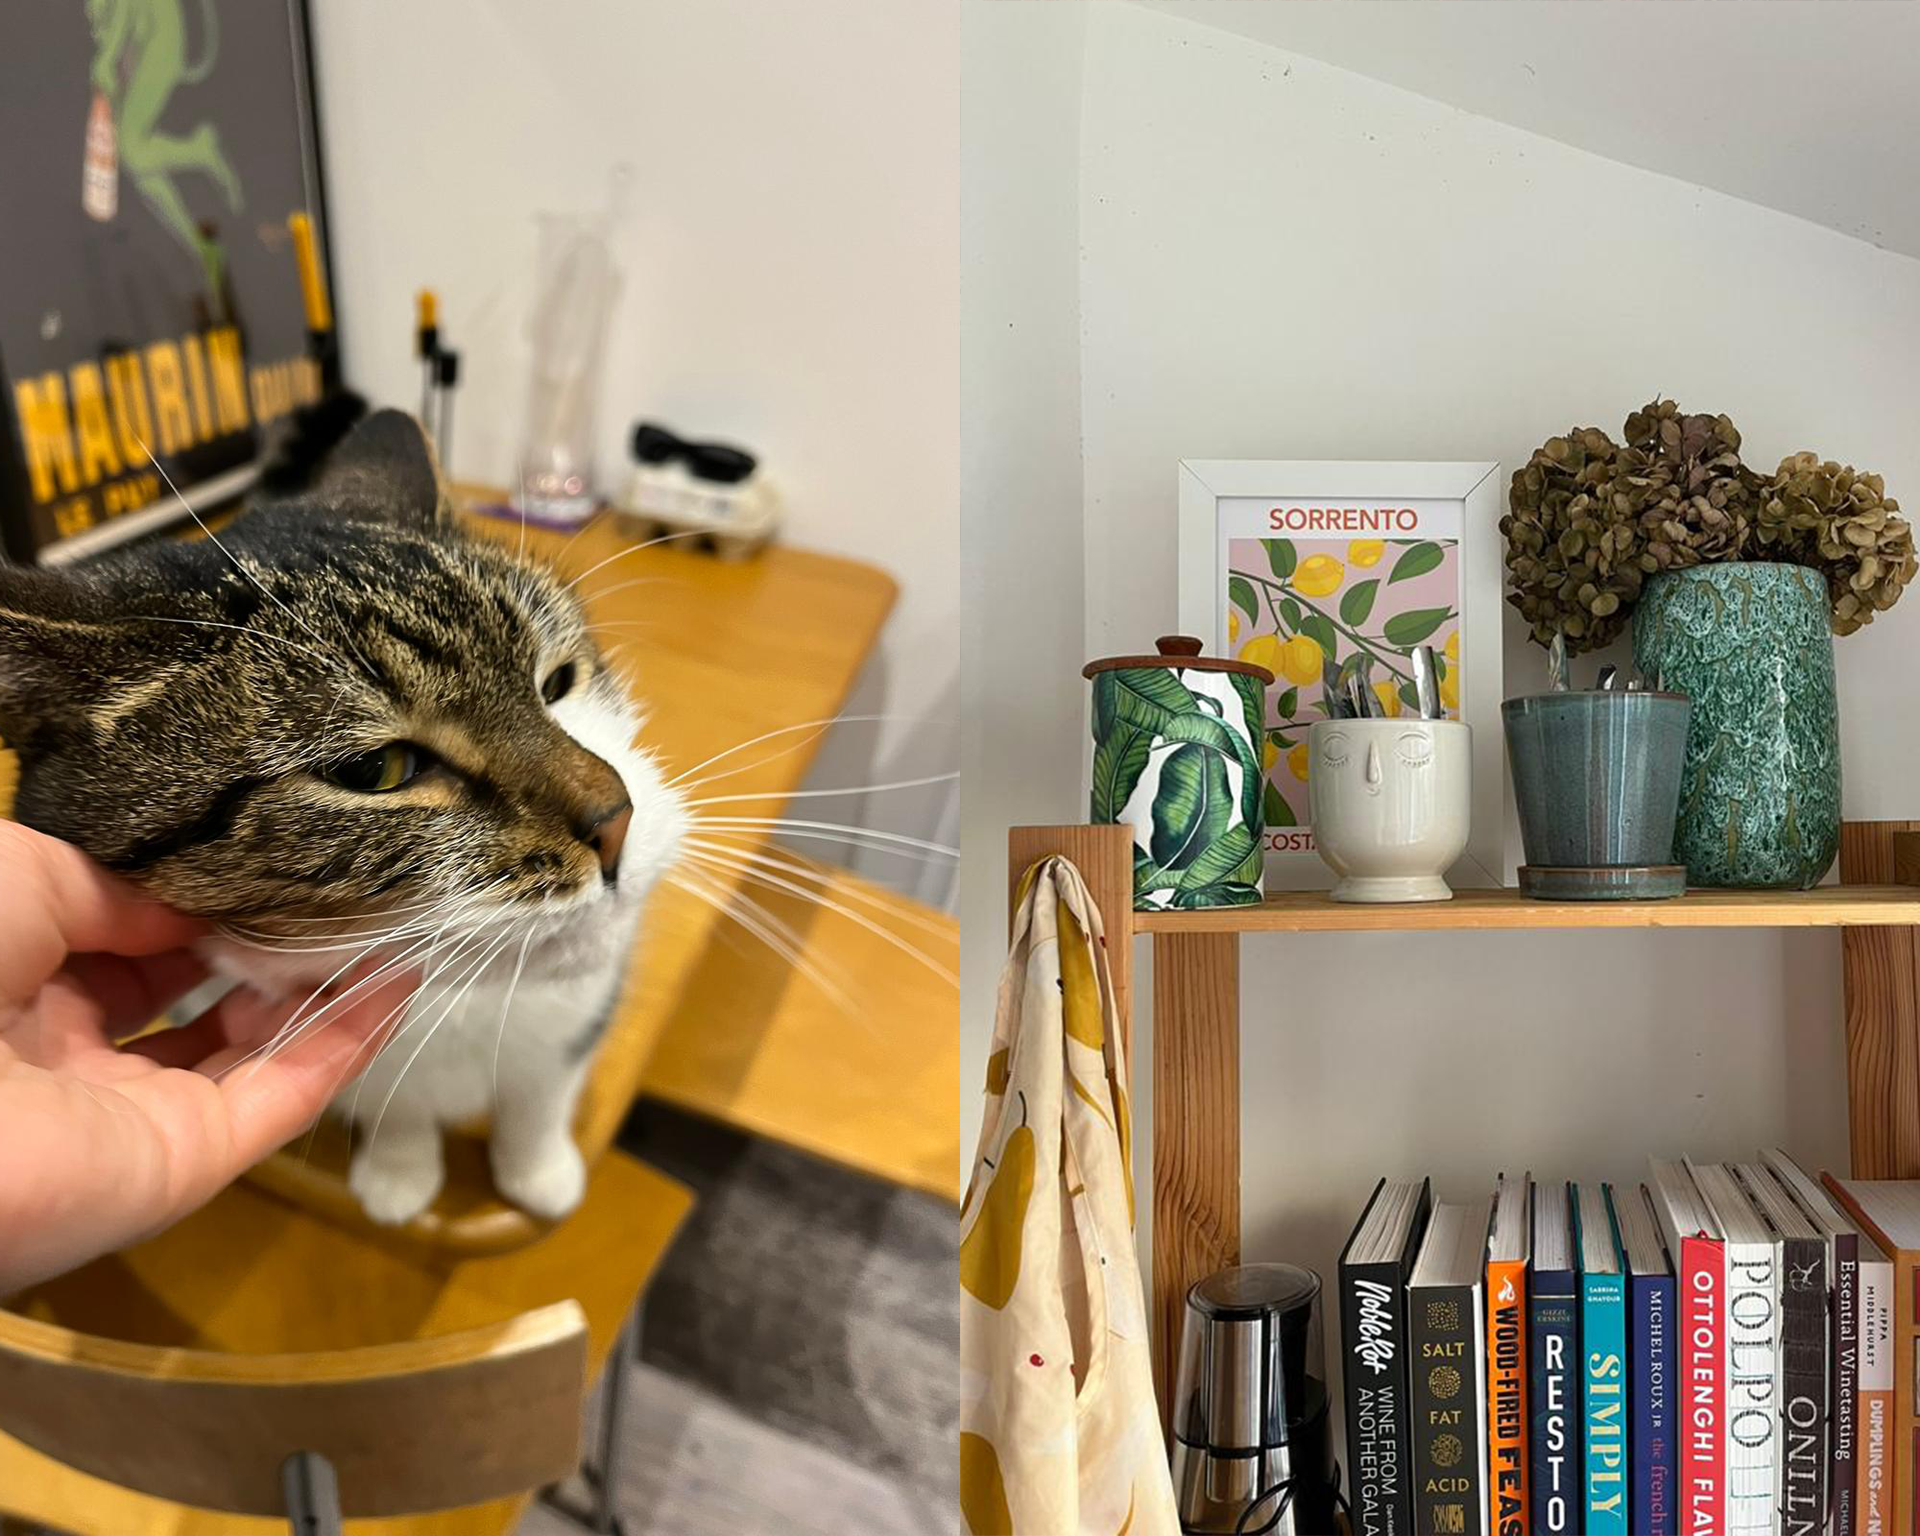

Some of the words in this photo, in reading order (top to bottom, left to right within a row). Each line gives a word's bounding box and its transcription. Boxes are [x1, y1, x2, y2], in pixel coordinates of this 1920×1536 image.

[1270, 508, 1418, 530] SORRENTO
[1264, 833, 1316, 851] COST
[1650, 1290, 1662, 1358] MICHEL
[1840, 1260, 1855, 1341] Essential
[1867, 1286, 1875, 1367] MIDDLEHURST
[1880, 1308, 1888, 1341] PIPPA
[1423, 1342, 1465, 1357] SALT
[1495, 1305, 1521, 1440] WOOD-FIRED
[1693, 1271, 1714, 1461] OTTOLENGHI
[1730, 1257, 1773, 1448] POLPO
[1377, 1386, 1395, 1434] WINE
[1651, 1361, 1663, 1409] ROUX
[1835, 1349, 1855, 1460] Winetasting
[1357, 1387, 1378, 1480] ANOTHER
[1430, 1410, 1462, 1425] FAT
[1546, 1334, 1565, 1532] RESTO
[1589, 1352, 1622, 1519] SIMPLY
[1652, 1438, 1665, 1459] the
[1868, 1400, 1883, 1490] DUMPLINGS
[1380, 1438, 1398, 1495] FROM
[1425, 1478, 1470, 1493] ACID
[1497, 1447, 1523, 1536] FEAS
[1651, 1466, 1668, 1524] french
[1841, 1489, 1850, 1536] MICHAEL
